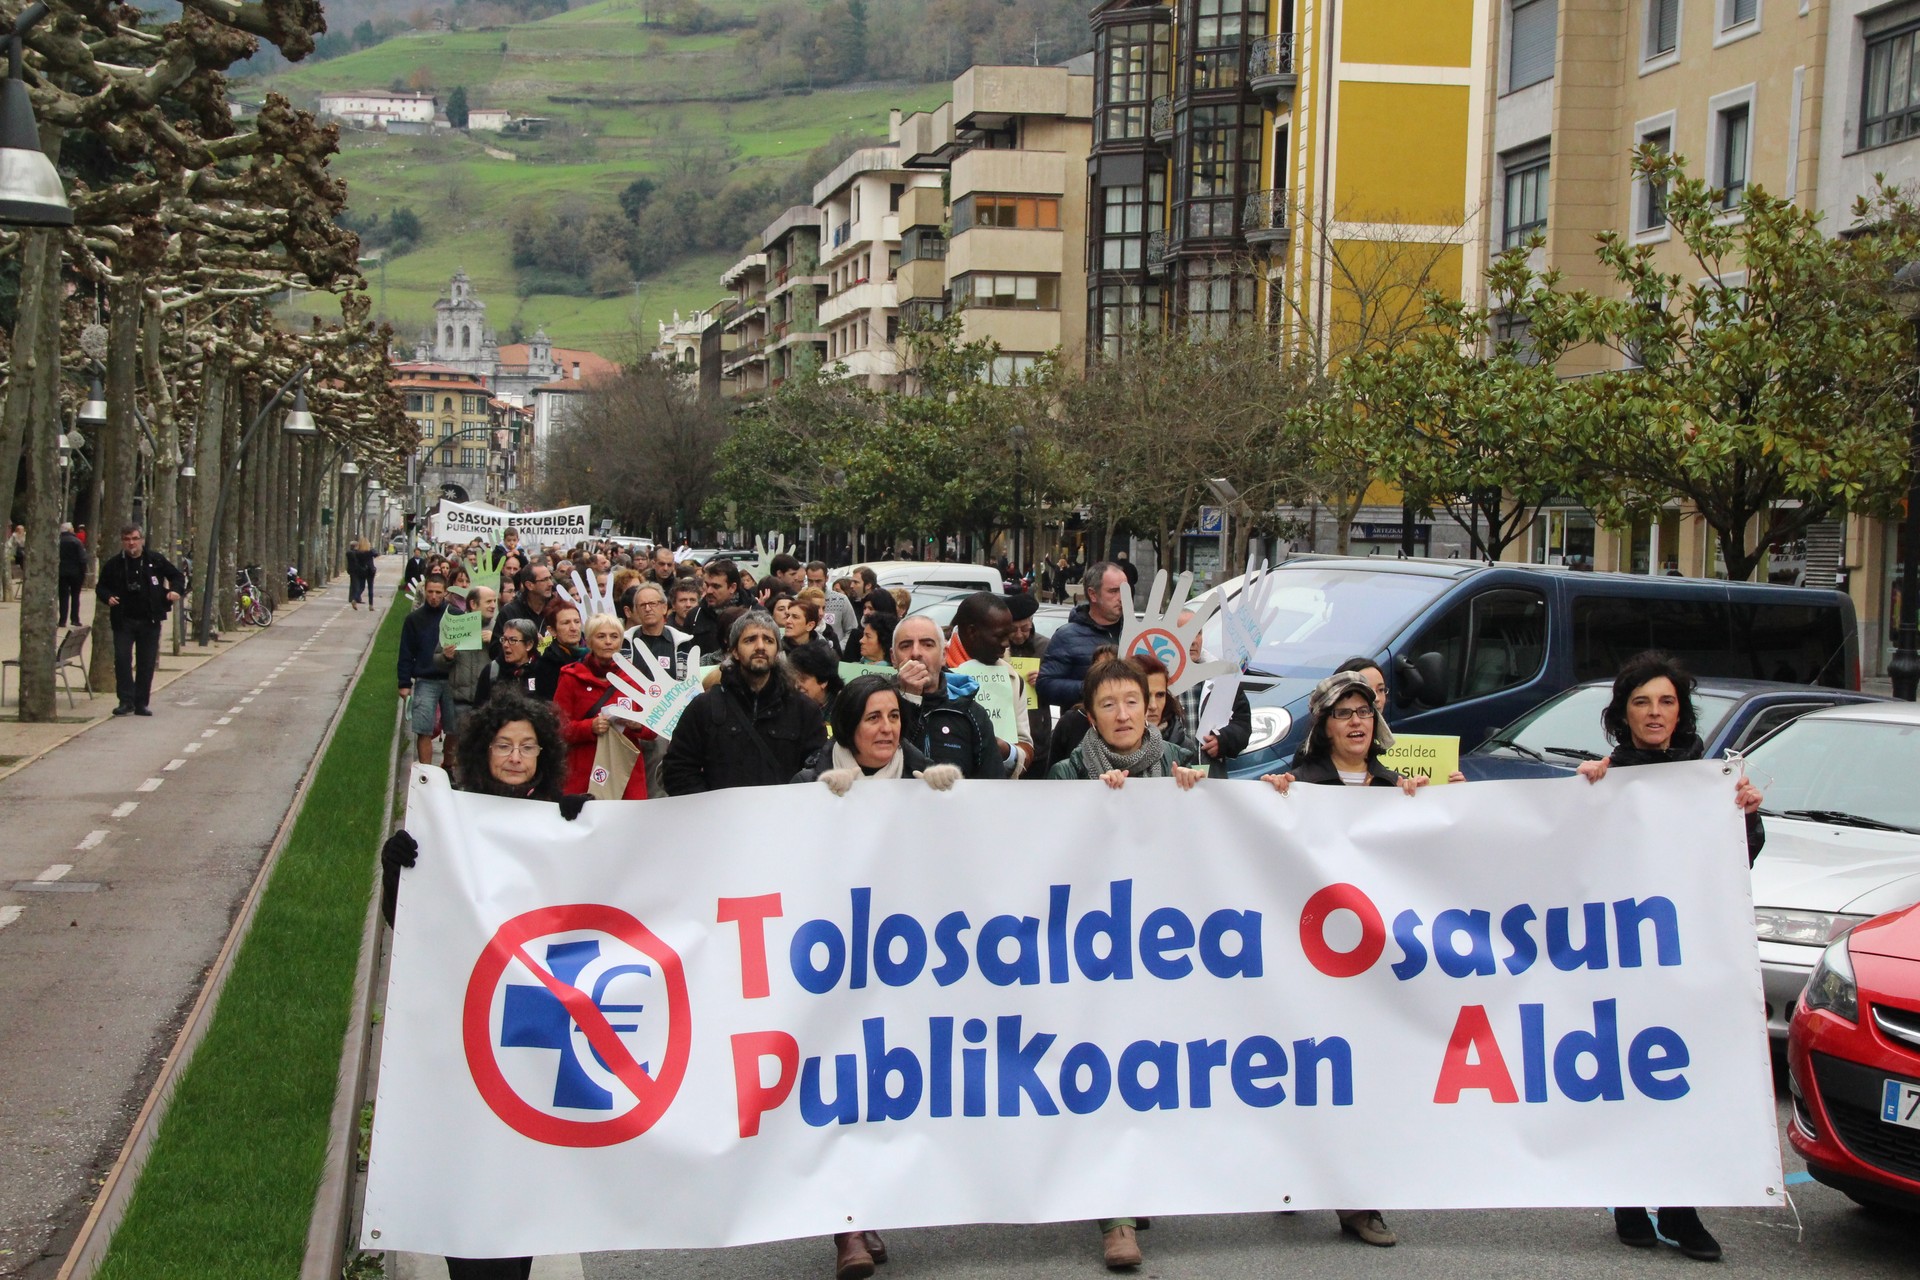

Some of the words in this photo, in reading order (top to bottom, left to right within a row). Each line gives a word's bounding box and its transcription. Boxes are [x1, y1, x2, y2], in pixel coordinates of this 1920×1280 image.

[447, 510, 501, 526] OSASUN
[508, 514, 585, 527] ESKUBIDEA
[446, 523, 493, 534] PUBLIKOA
[520, 526, 584, 535] KALITATEZKOA
[991, 672, 1005, 683] eta
[716, 879, 1264, 999] Tolosaldea
[1299, 882, 1682, 981] Osasun
[730, 1014, 1354, 1139] Publikoaren
[1433, 998, 1691, 1104] Alde
